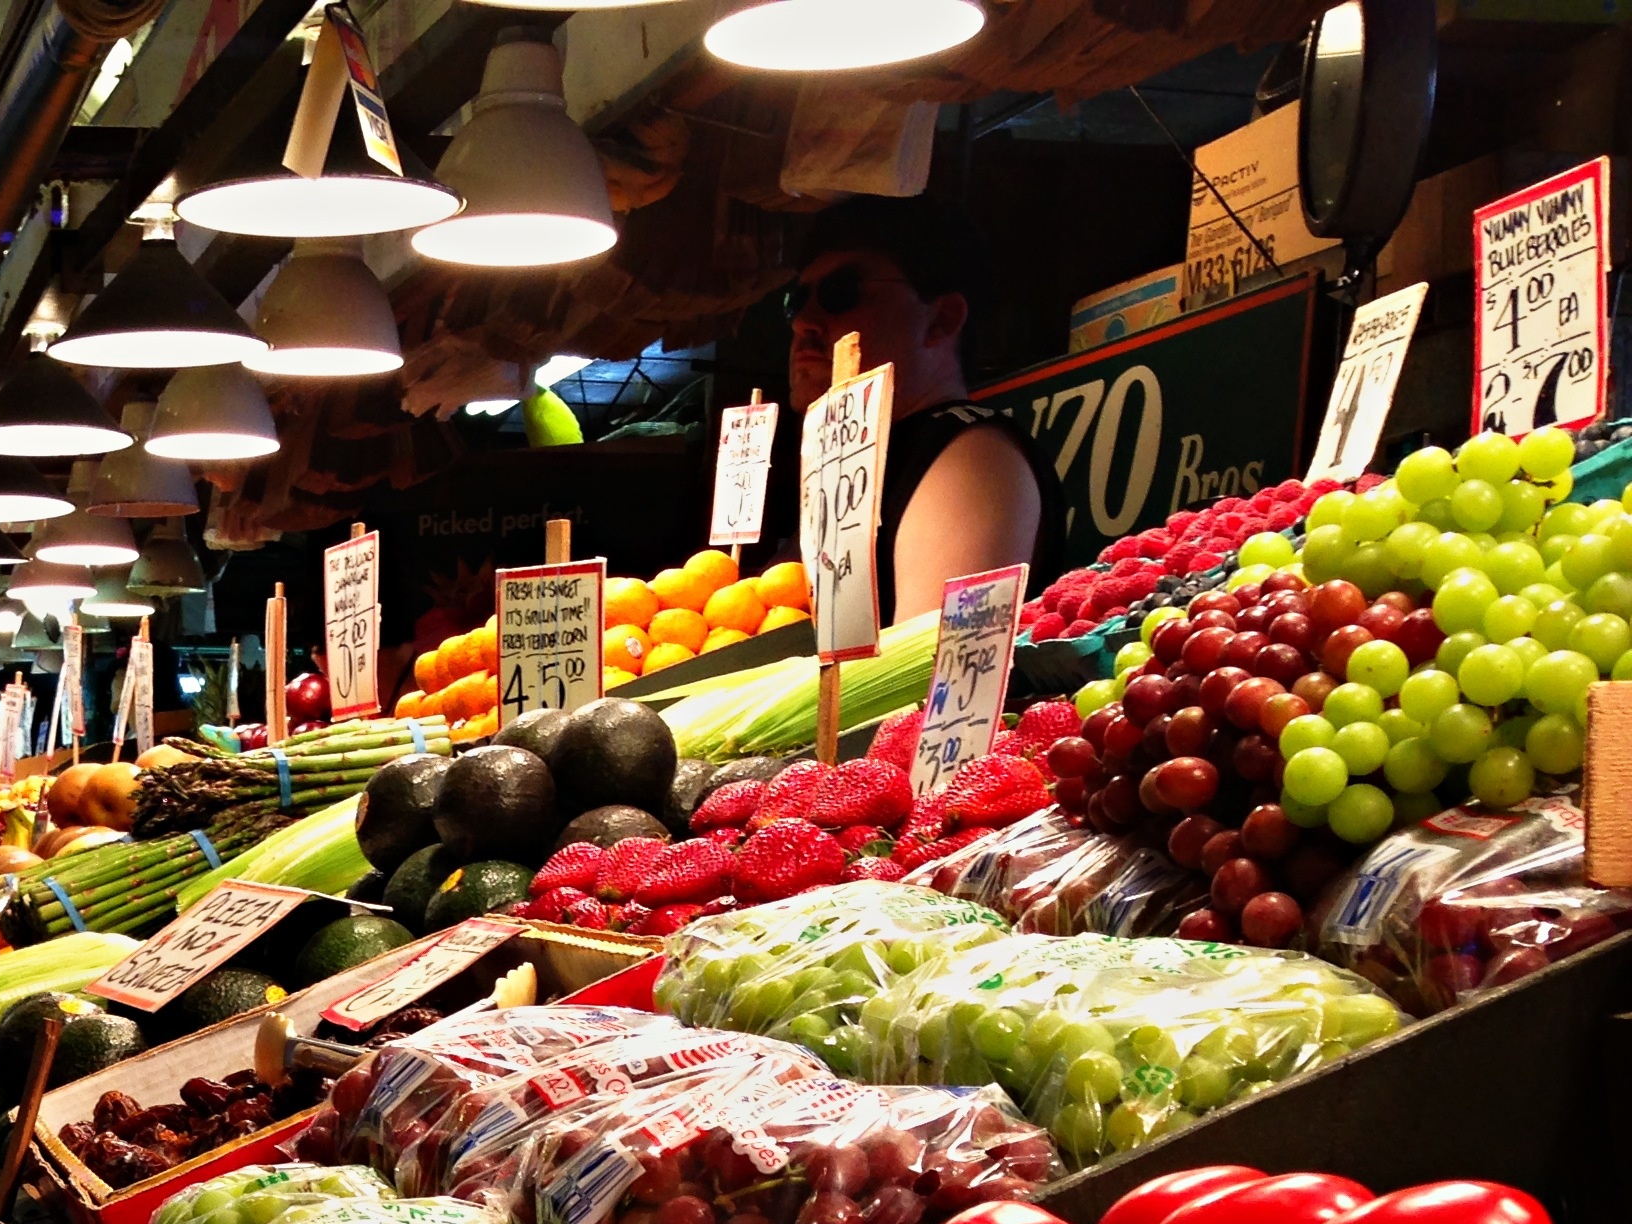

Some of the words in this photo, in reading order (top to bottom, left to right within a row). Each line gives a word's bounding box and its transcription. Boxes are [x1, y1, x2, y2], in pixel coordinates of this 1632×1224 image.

[1488, 214, 1592, 278] BLUEBERRIES
[417, 506, 494, 537] Picked
[561, 625, 588, 646] CORN
[190, 890, 285, 928] PLEEZA
[107, 950, 207, 994] SQUEEZA
